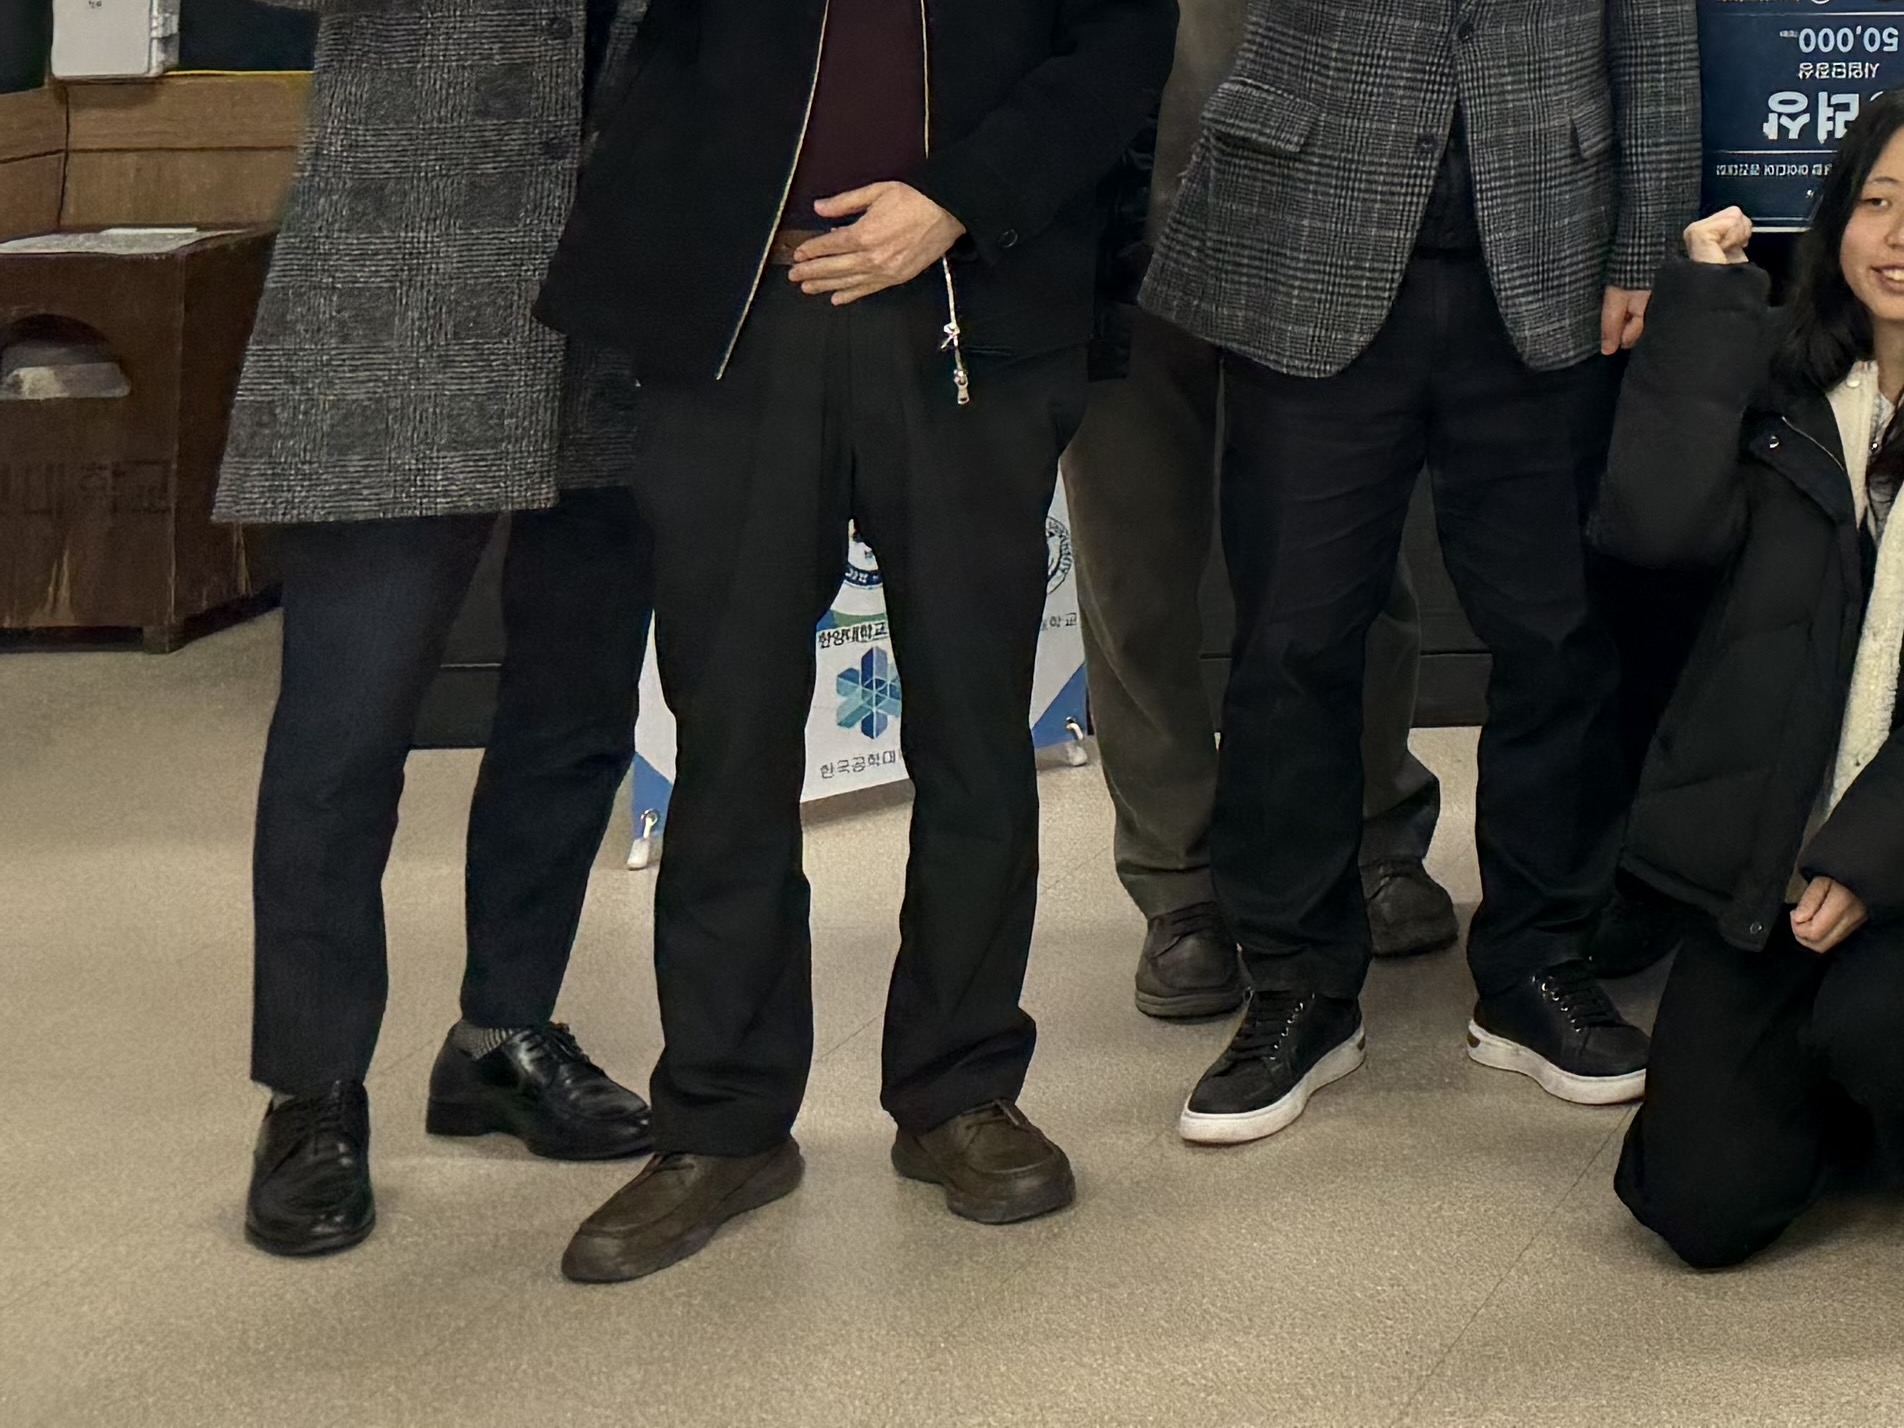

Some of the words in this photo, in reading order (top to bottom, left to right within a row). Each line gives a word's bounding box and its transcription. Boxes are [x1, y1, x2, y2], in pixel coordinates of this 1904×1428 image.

[1798, 26, 1899, 54] 50,000
[1762, 90, 1884, 145] 려상
[820, 749, 900, 780] 한국공학대
